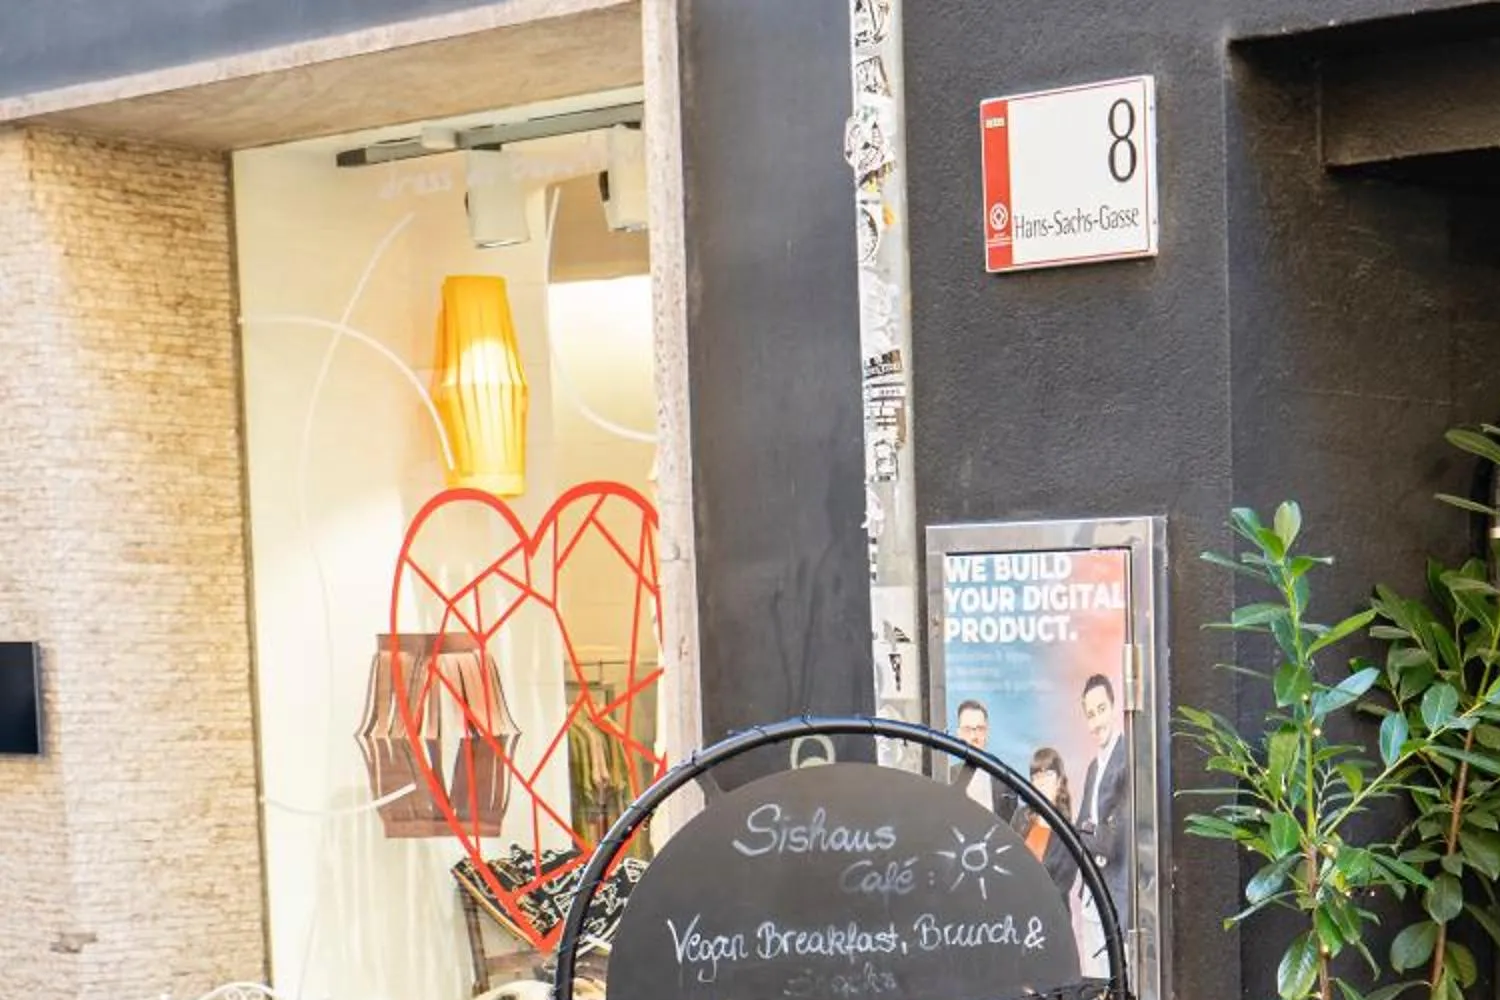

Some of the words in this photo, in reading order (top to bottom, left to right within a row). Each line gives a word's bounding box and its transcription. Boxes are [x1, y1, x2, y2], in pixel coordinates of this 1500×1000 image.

[1107, 97, 1138, 183] 8
[1014, 204, 1140, 241] Hans-Sachs-Gasse
[946, 557, 986, 584] WE
[994, 553, 1072, 582] BUILD
[946, 586, 1016, 614] YOUR
[1022, 582, 1125, 612] DIGITAL
[946, 614, 1077, 645] PRODUCT.
[732, 804, 897, 857] Sishaus
[666, 914, 748, 983] Vegan
[915, 913, 1016, 951] Brunch
[1022, 916, 1047, 950] &
